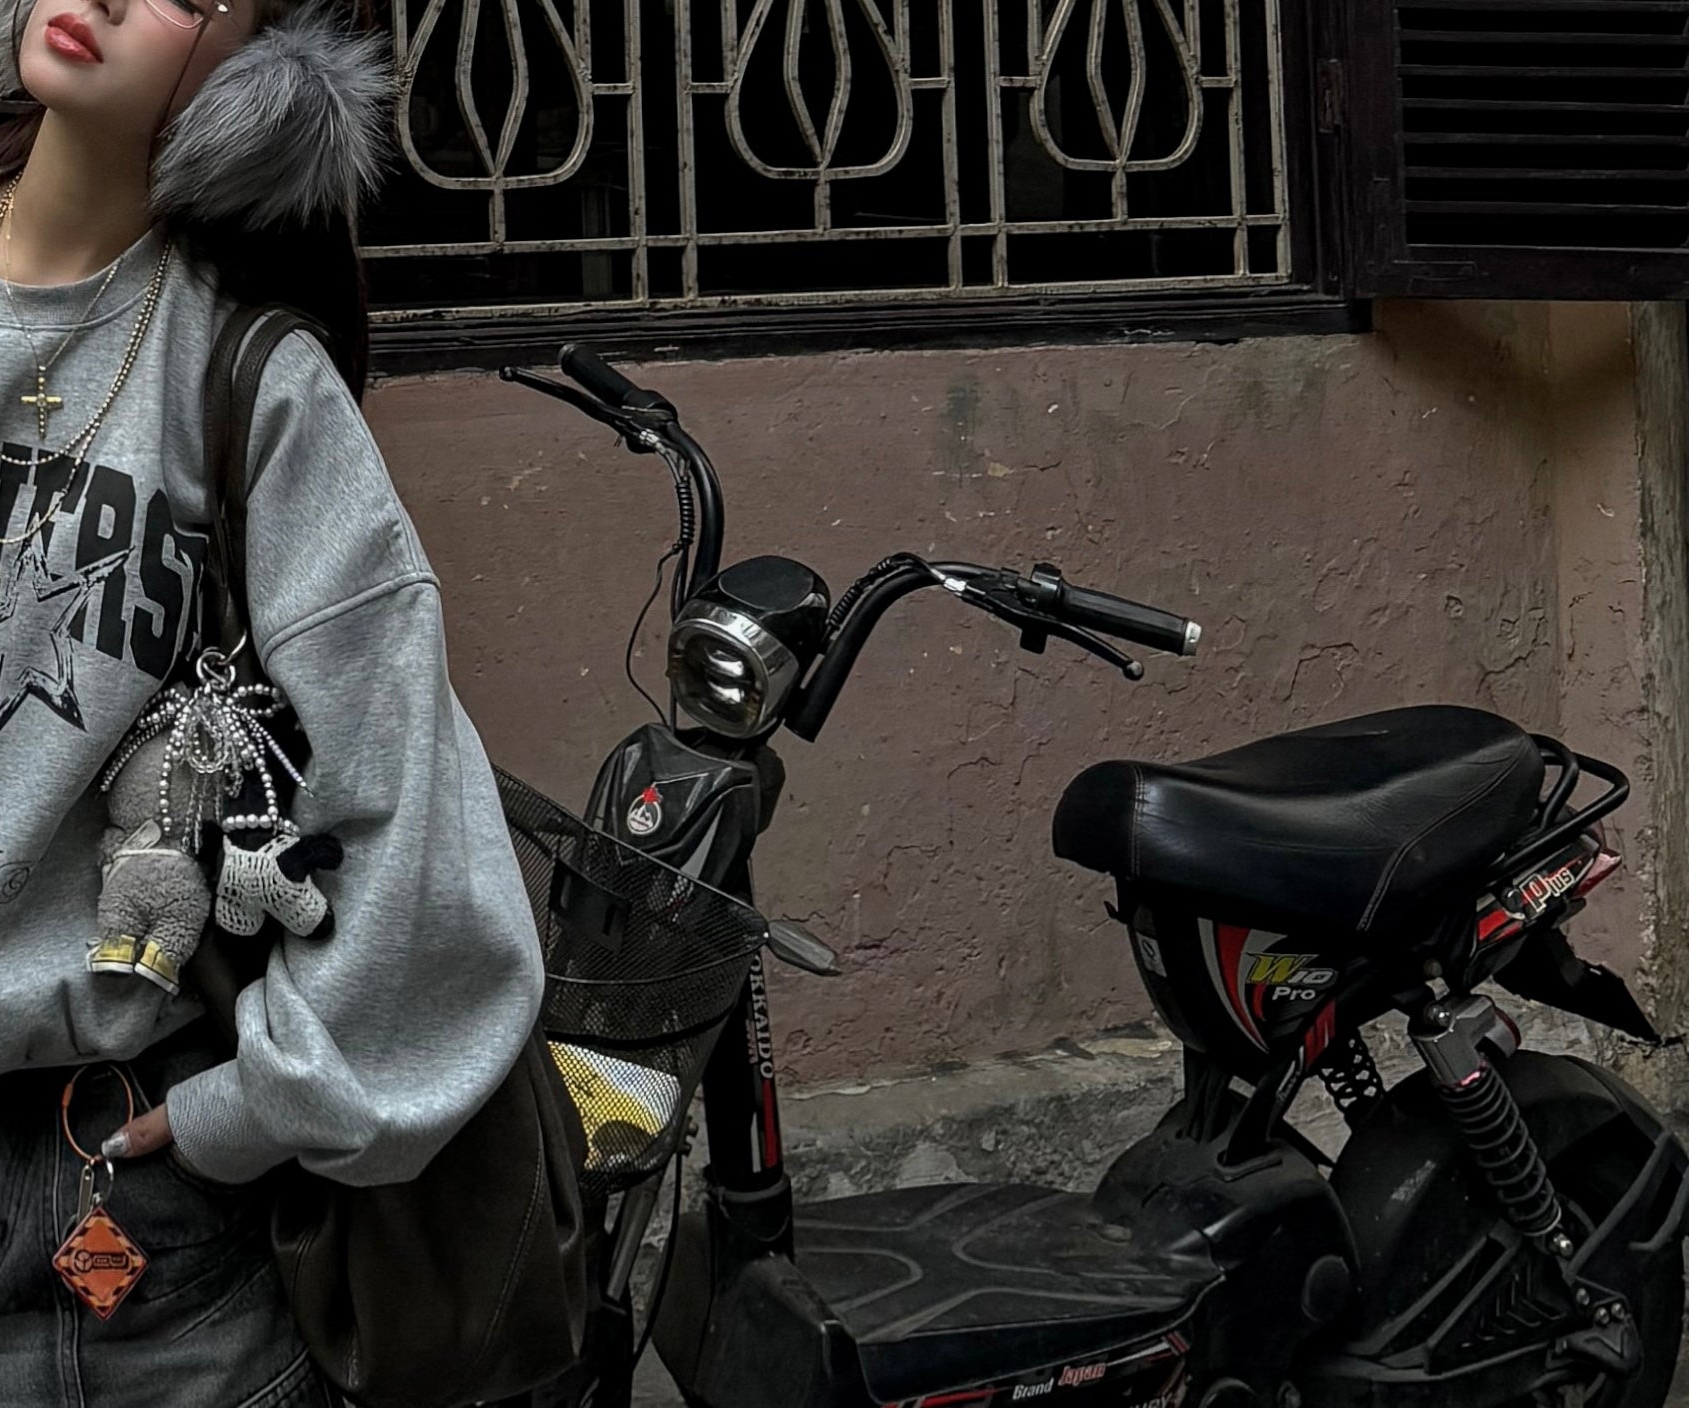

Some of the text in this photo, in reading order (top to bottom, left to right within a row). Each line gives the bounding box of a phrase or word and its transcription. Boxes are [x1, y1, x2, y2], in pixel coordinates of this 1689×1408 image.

[1518, 866, 1575, 912] Plus
[1271, 985, 1316, 1001] Pro
[748, 953, 774, 1080] OKKAIDO
[1012, 1377, 1055, 1400] Brand
